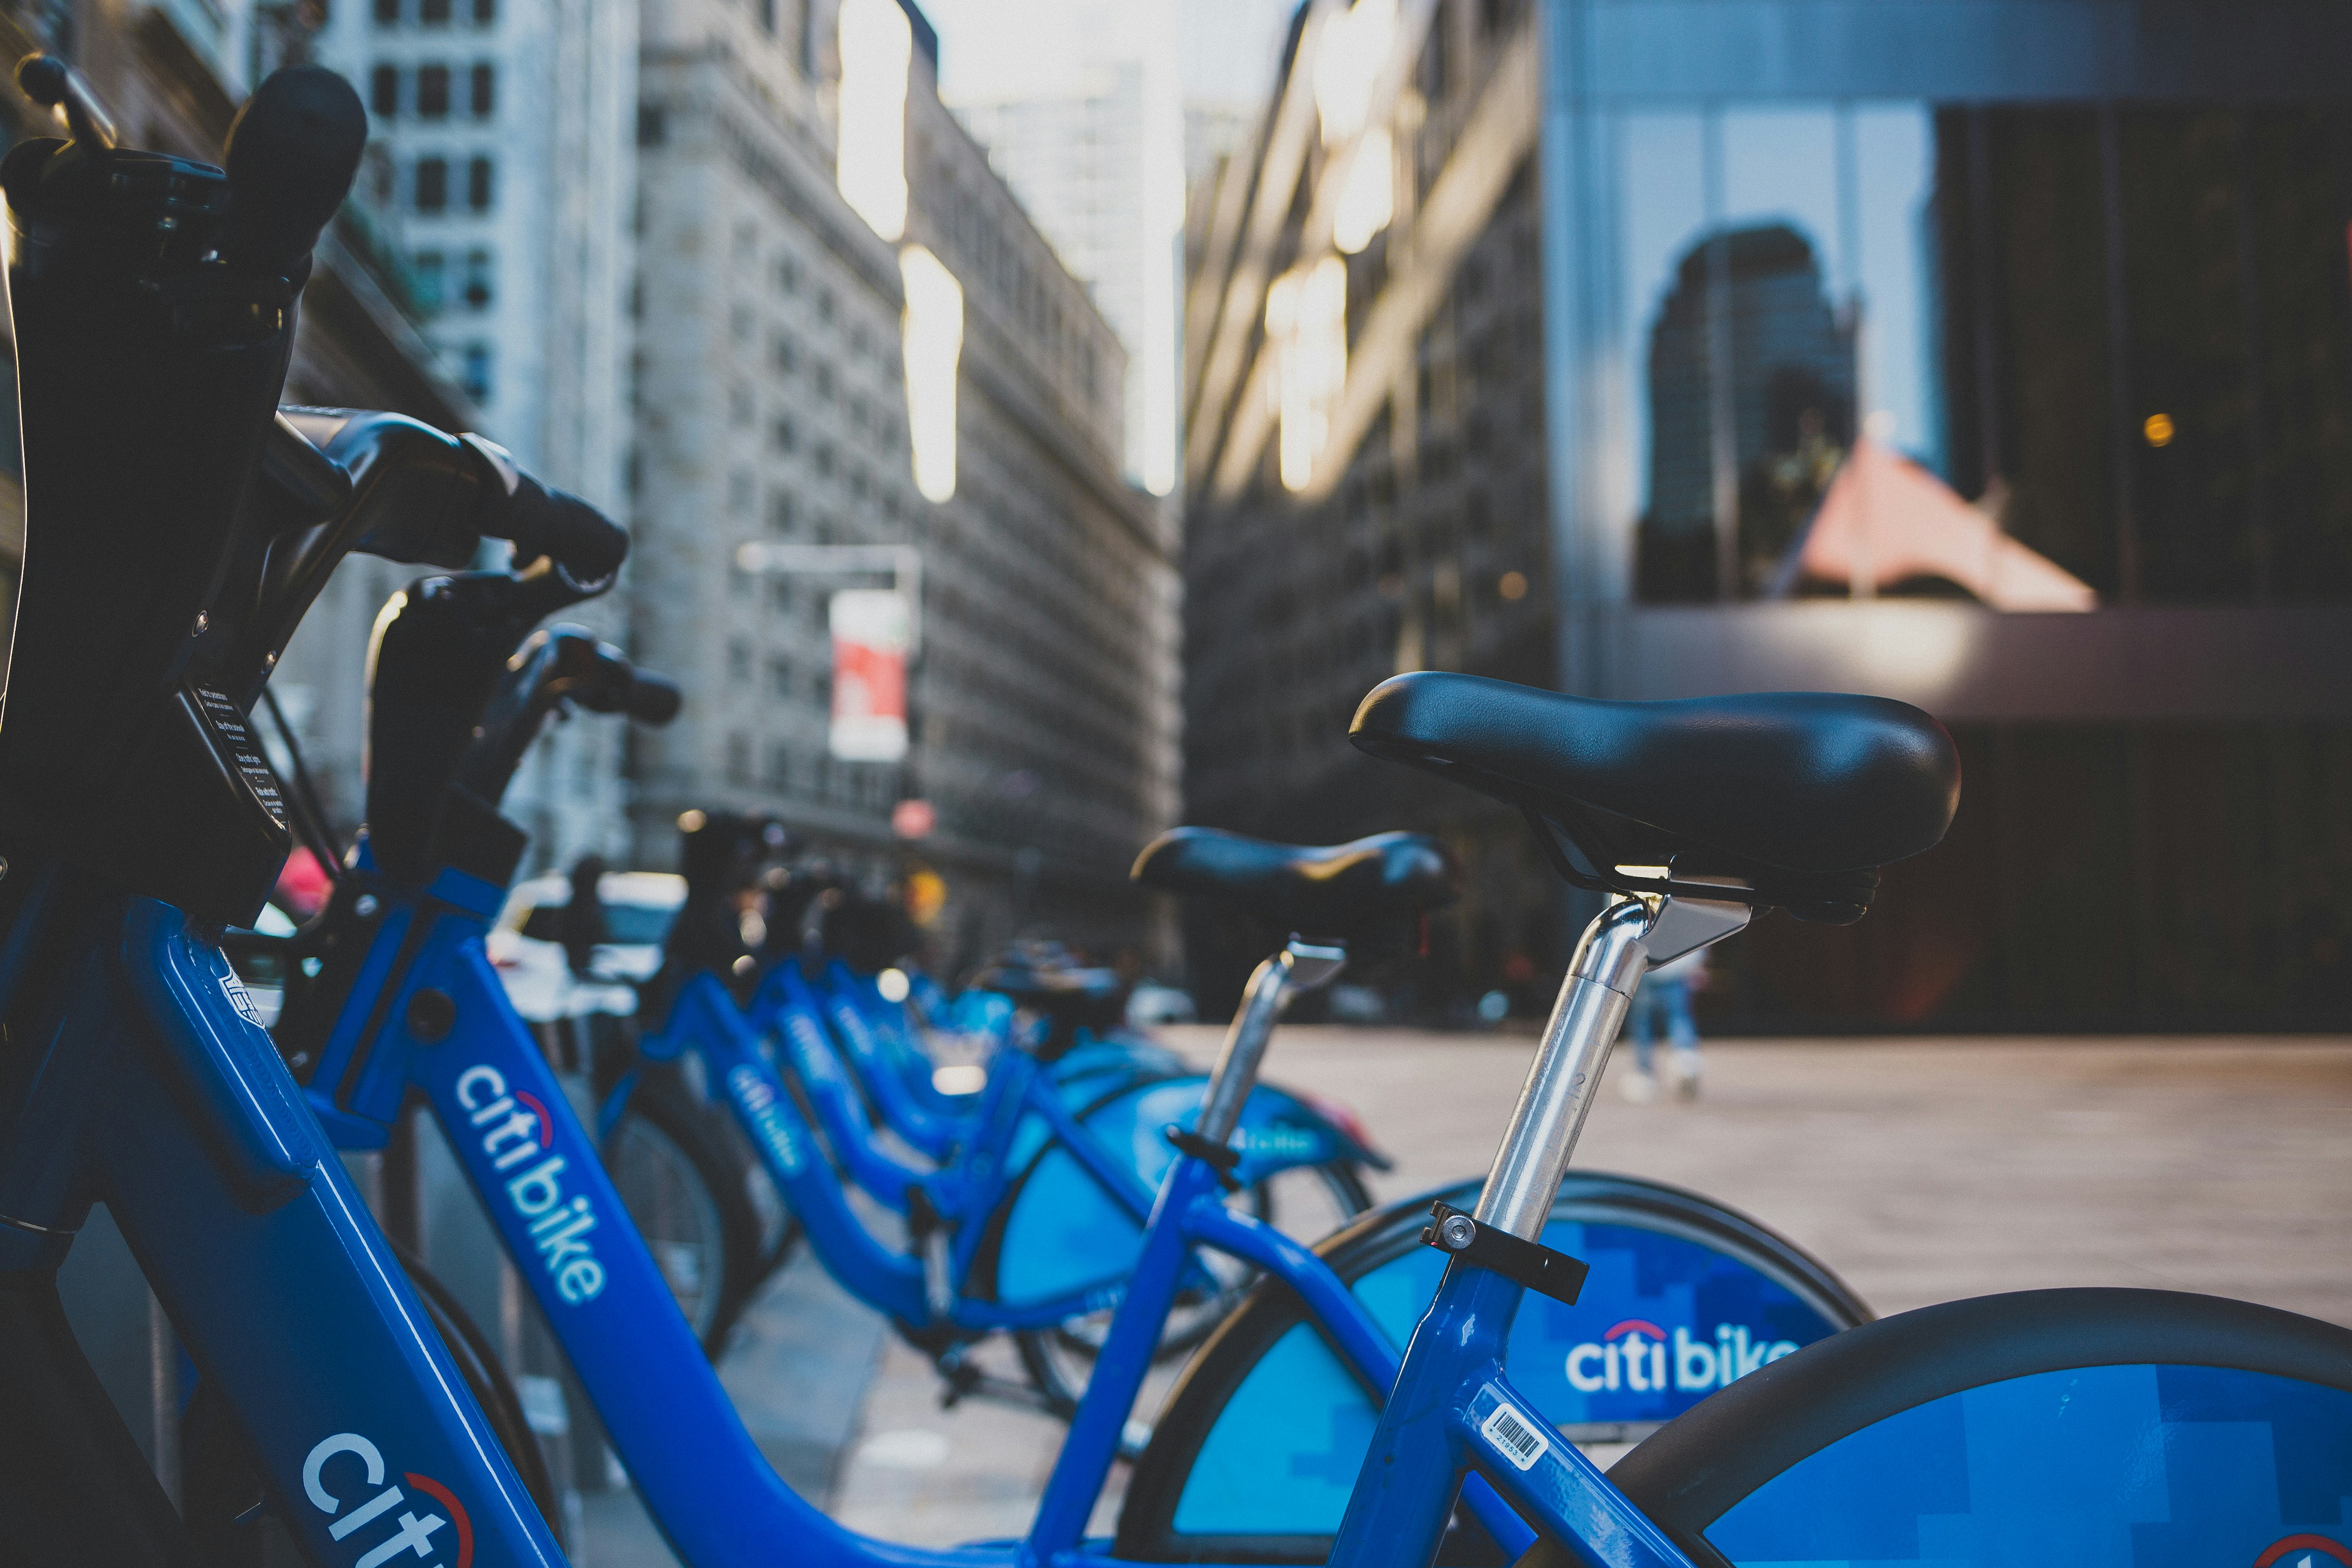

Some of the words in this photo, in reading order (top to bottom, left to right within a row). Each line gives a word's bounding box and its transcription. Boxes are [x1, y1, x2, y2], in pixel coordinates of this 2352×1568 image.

[456, 1064, 540, 1171] citi
[506, 1154, 606, 1304] bike
[1565, 1331, 1667, 1392] citi
[1496, 1435, 1518, 1456] 21953
[303, 1433, 447, 1568] cit
